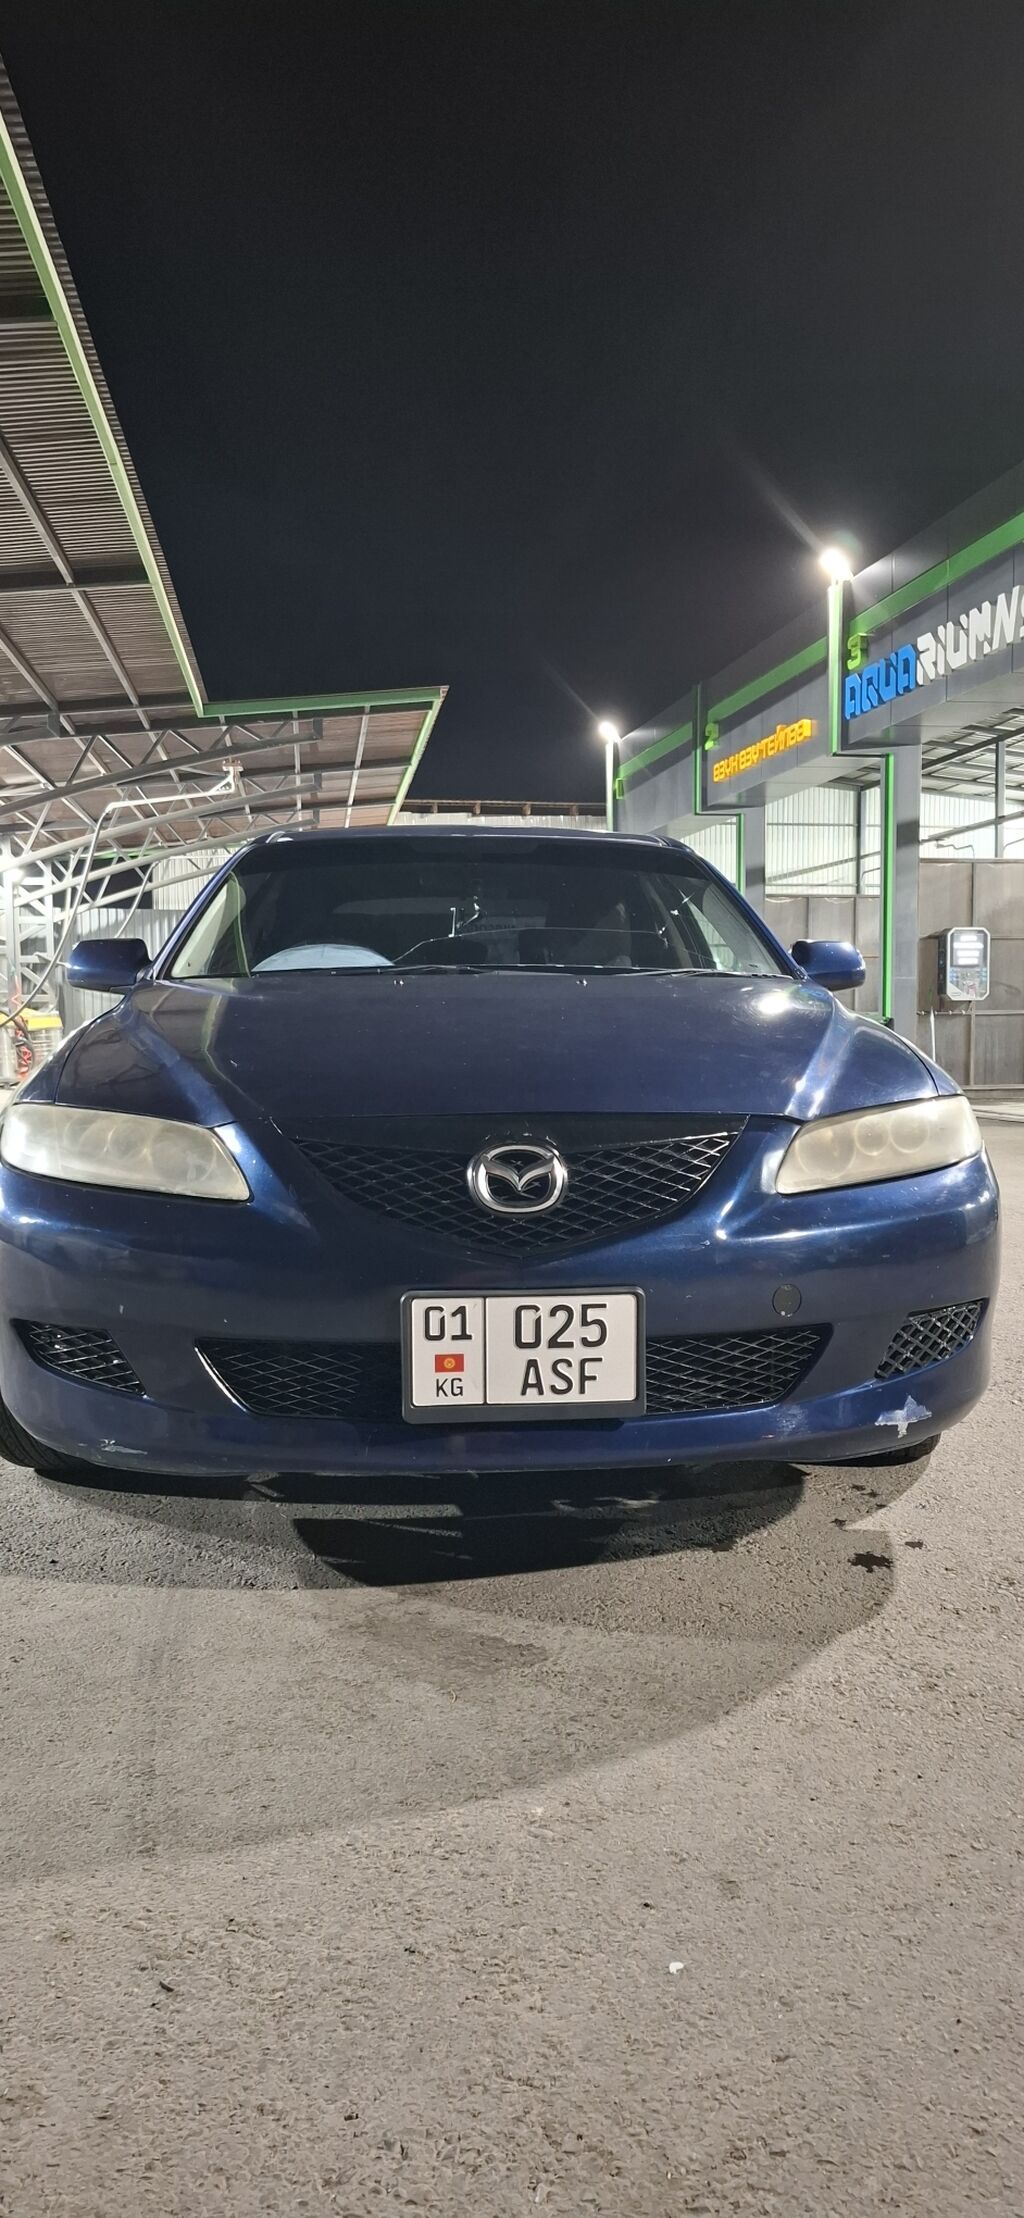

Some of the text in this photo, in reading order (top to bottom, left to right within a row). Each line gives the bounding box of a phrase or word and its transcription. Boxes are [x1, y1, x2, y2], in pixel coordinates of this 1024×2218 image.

[847, 633, 863, 671] 3
[424, 1304, 473, 1342] 01
[513, 1303, 608, 1350] 025
[435, 1377, 464, 1397] KG
[520, 1357, 603, 1396] ASF
